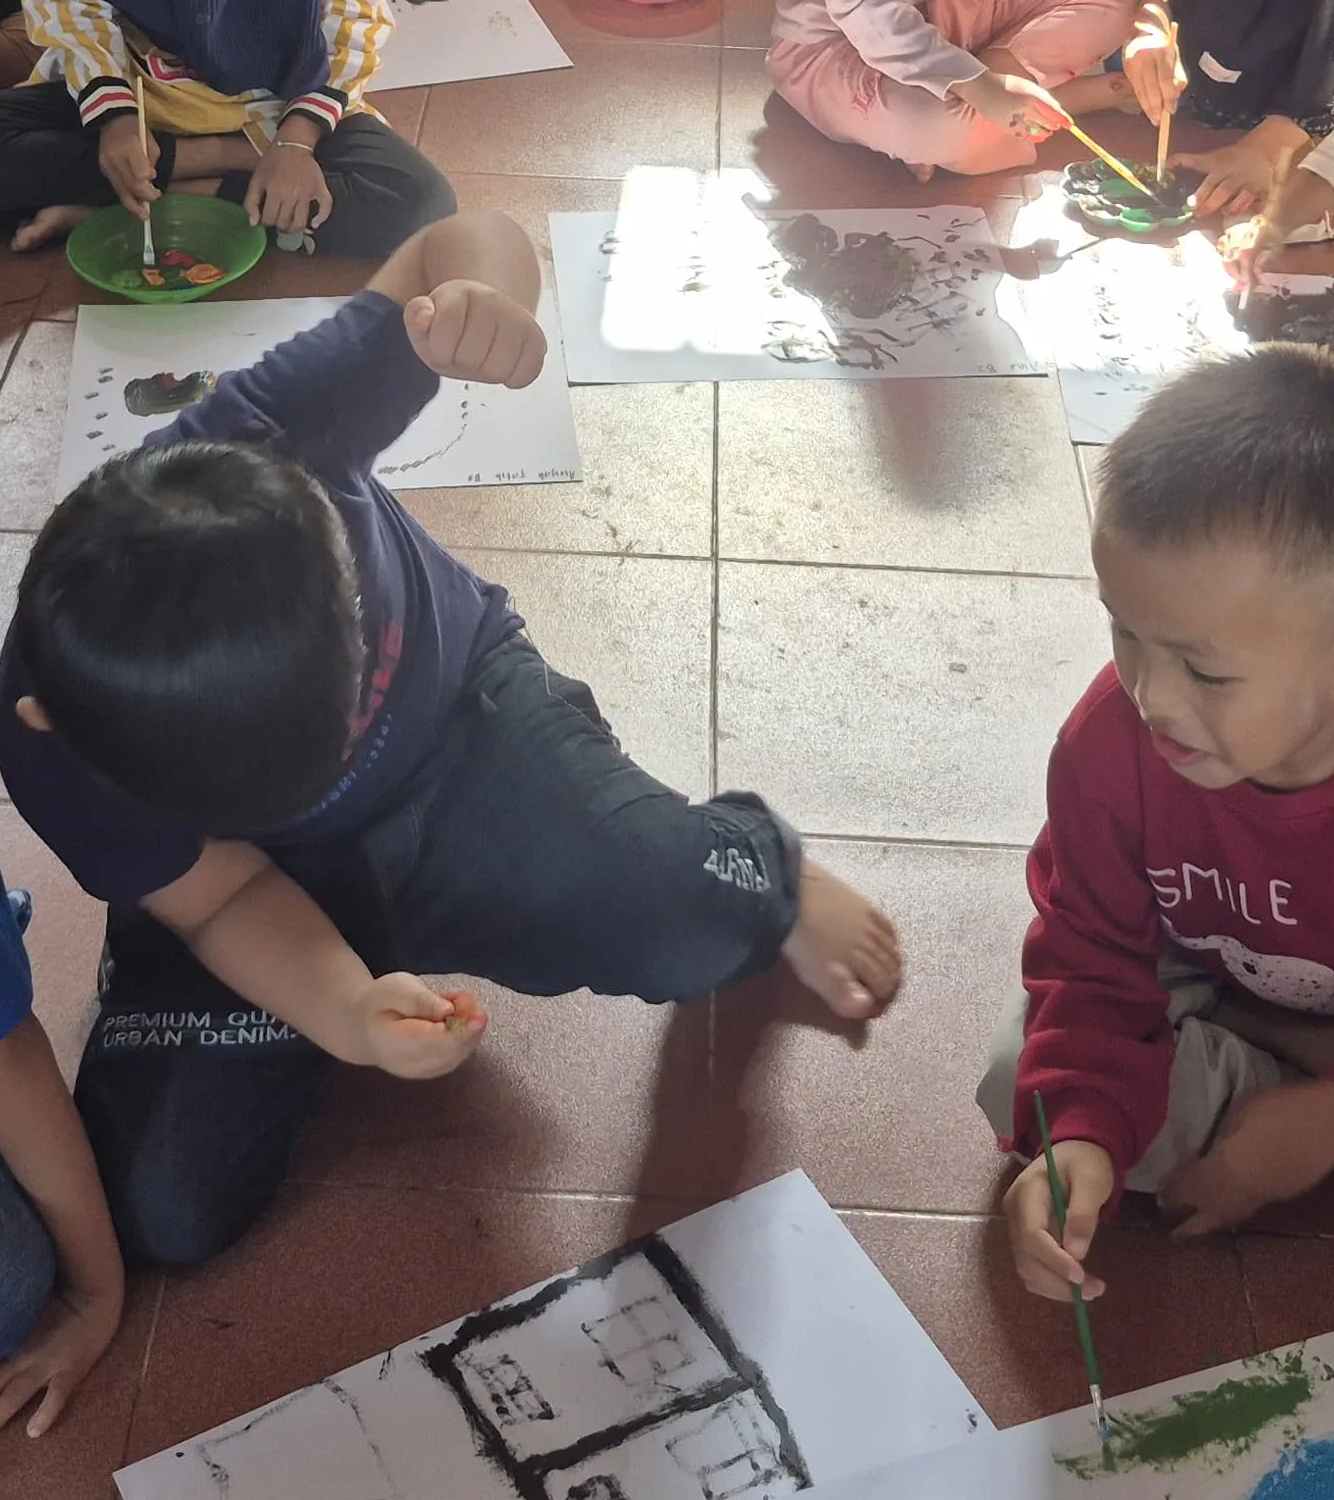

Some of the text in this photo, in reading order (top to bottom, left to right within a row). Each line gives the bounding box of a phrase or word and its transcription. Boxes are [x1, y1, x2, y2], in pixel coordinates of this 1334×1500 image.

[1146, 861, 1298, 925] SMILE
[103, 1011, 211, 1031] PREMIUM
[103, 1028, 183, 1048] URBAN
